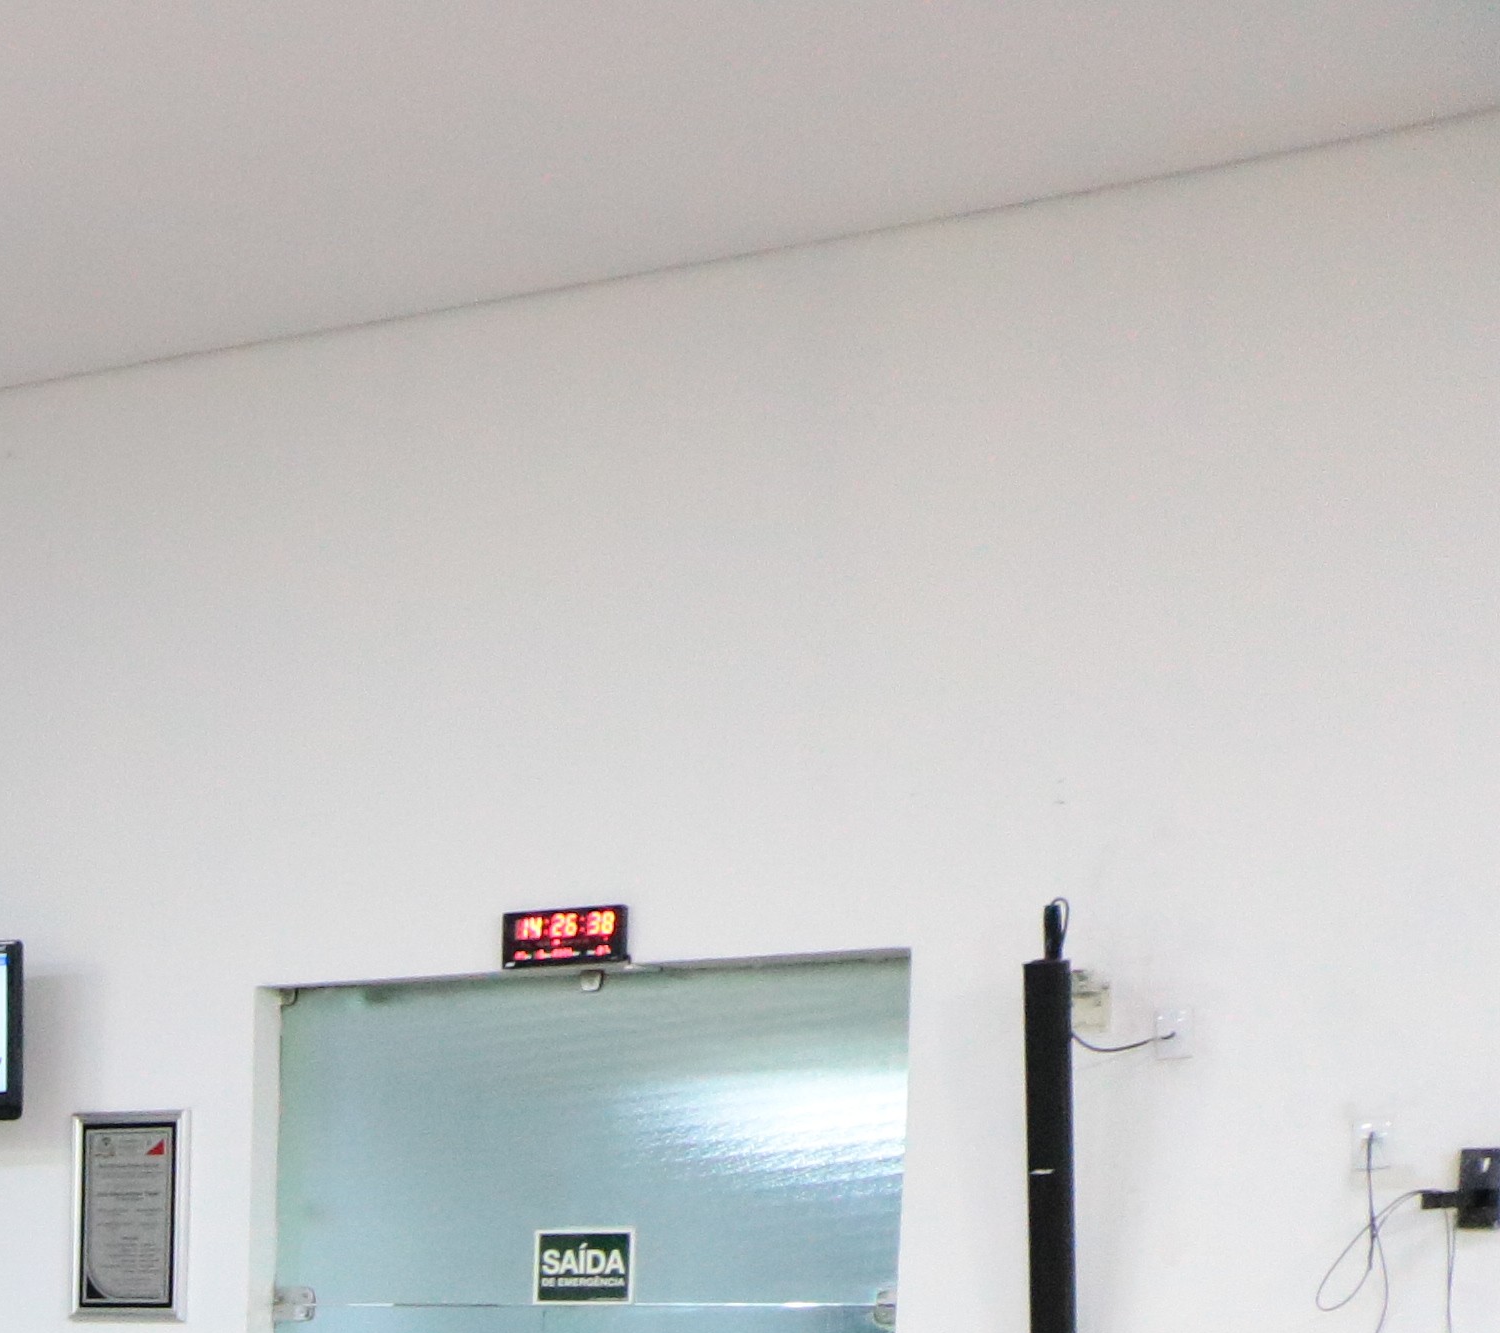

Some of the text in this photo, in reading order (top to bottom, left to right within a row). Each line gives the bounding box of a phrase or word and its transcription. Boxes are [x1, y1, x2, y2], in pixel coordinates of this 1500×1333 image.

[541, 1242, 626, 1275] SAÍDA
[541, 1276, 626, 1288] DE EMERGÊNCIA
